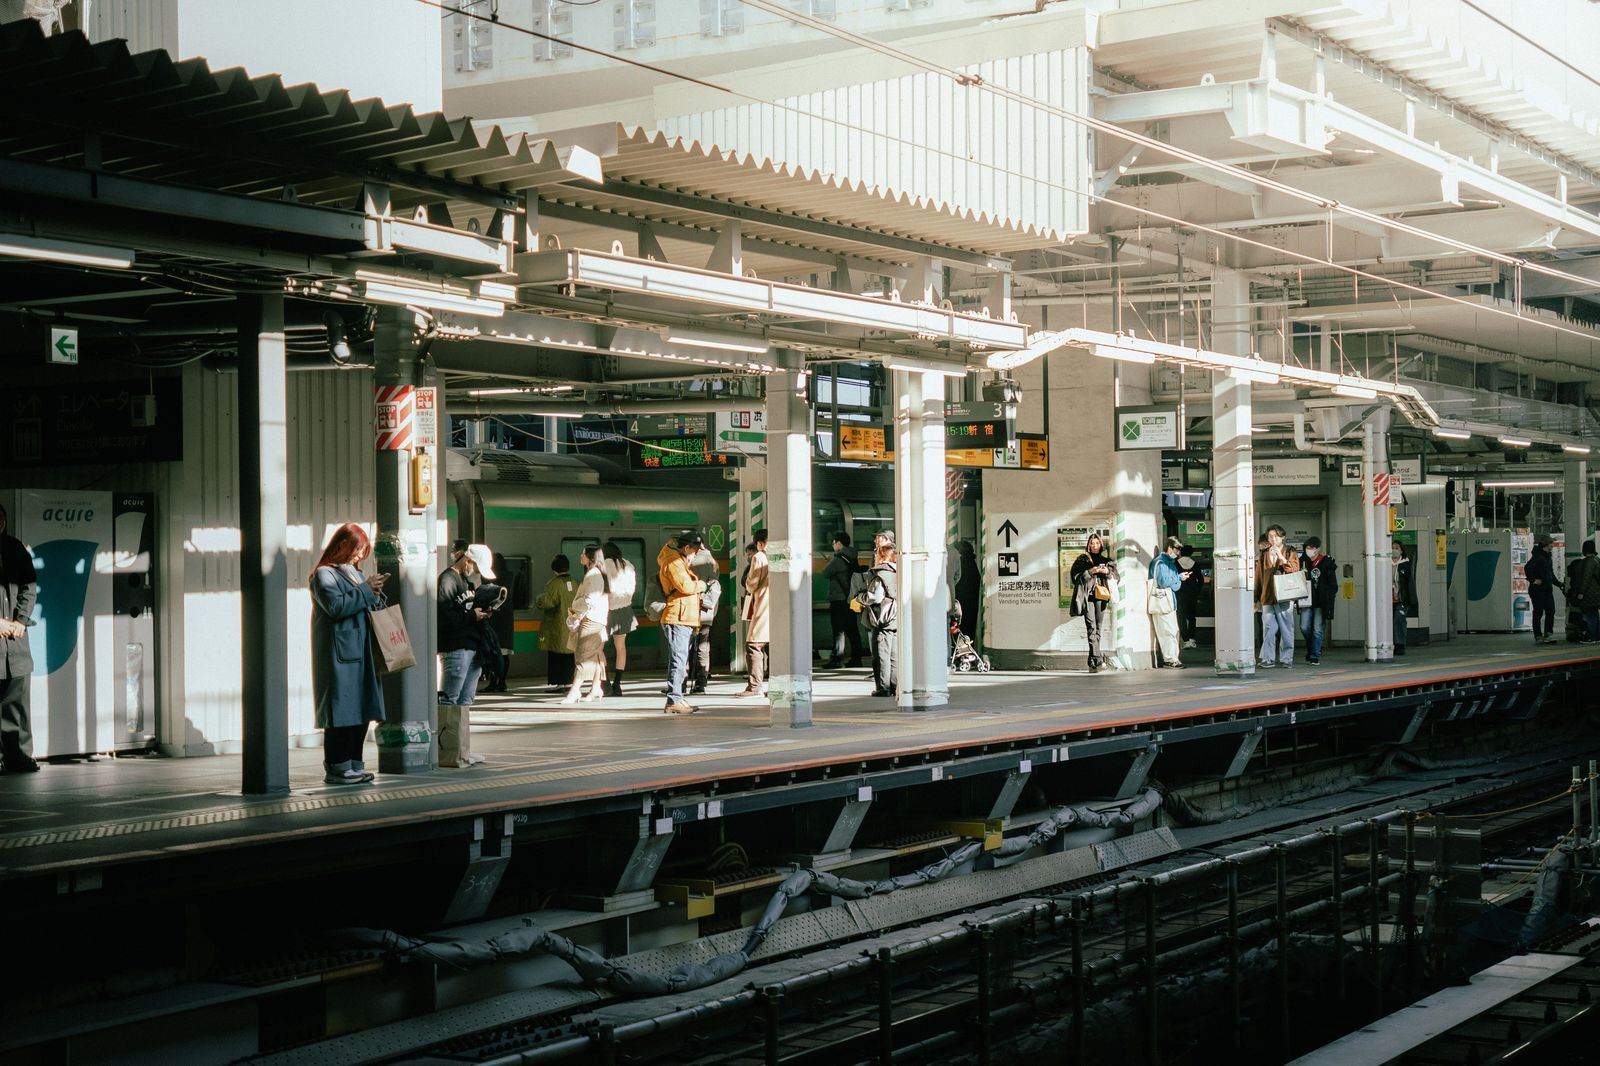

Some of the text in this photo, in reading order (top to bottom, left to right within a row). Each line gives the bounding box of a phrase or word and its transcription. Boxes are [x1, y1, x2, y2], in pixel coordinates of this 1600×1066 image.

[379, 405, 396, 414] STOP
[993, 403, 1003, 418] 3
[630, 420, 639, 434] 4
[42, 508, 94, 522] acure
[998, 580, 1051, 592] 指定席券売機
